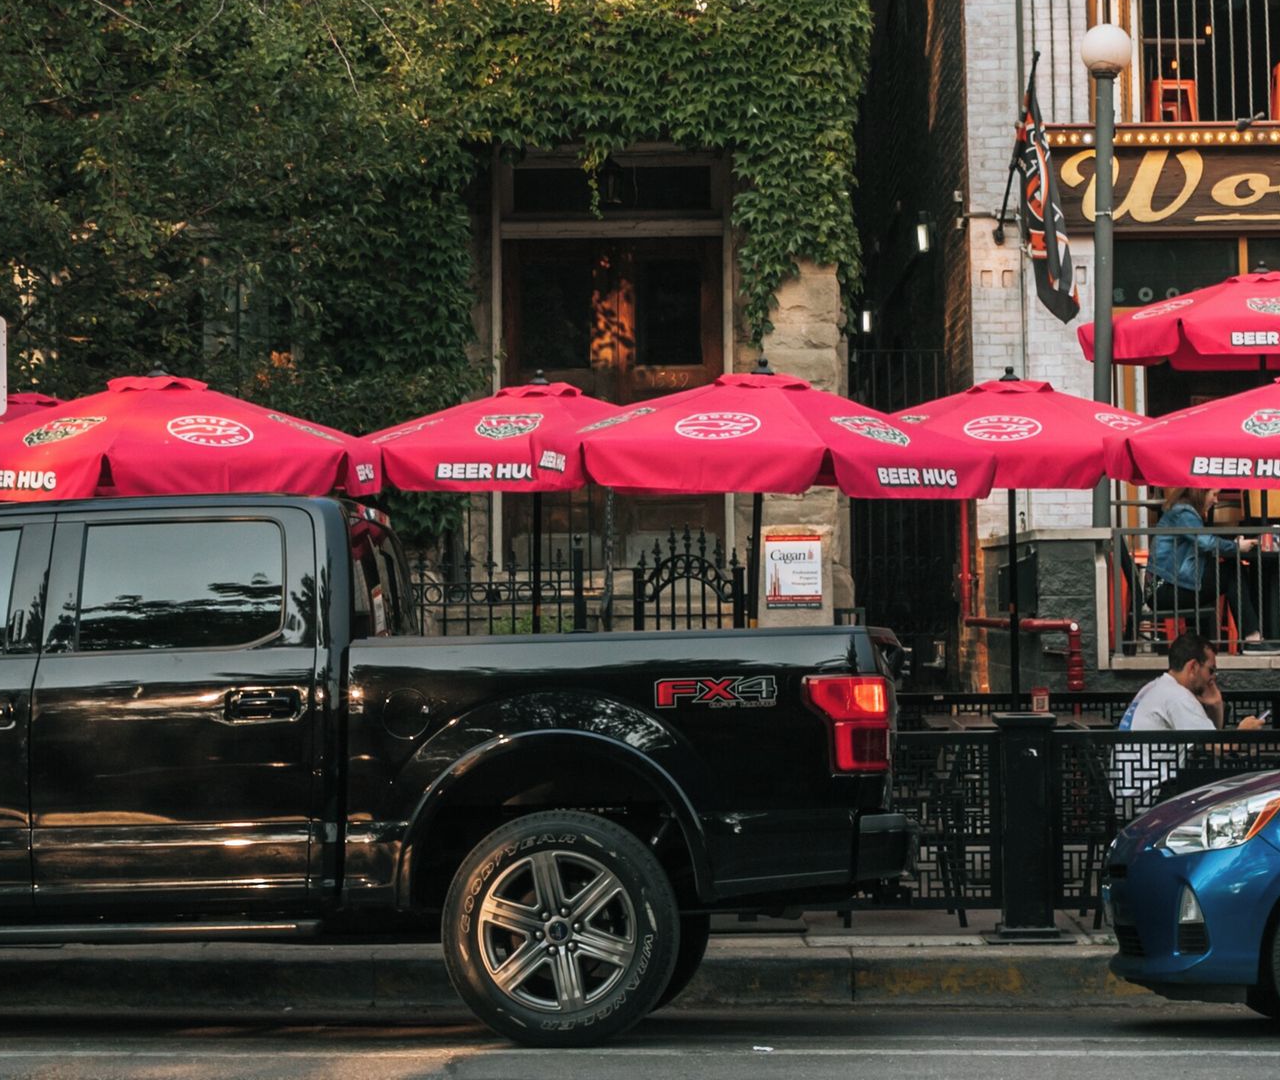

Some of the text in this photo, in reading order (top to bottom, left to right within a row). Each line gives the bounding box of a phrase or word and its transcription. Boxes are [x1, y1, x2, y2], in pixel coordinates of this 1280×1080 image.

[1232, 331, 1279, 346] BEER
[437, 463, 493, 479] BEER
[1192, 457, 1252, 476] BEER
[16, 471, 56, 489] HUG
[877, 468, 958, 487] BEER HUG
[770, 549, 806, 564] Cagan
[654, 675, 778, 709] FX4
[460, 833, 577, 934] GOODYEAR
[540, 934, 654, 1031] WRANGLER
